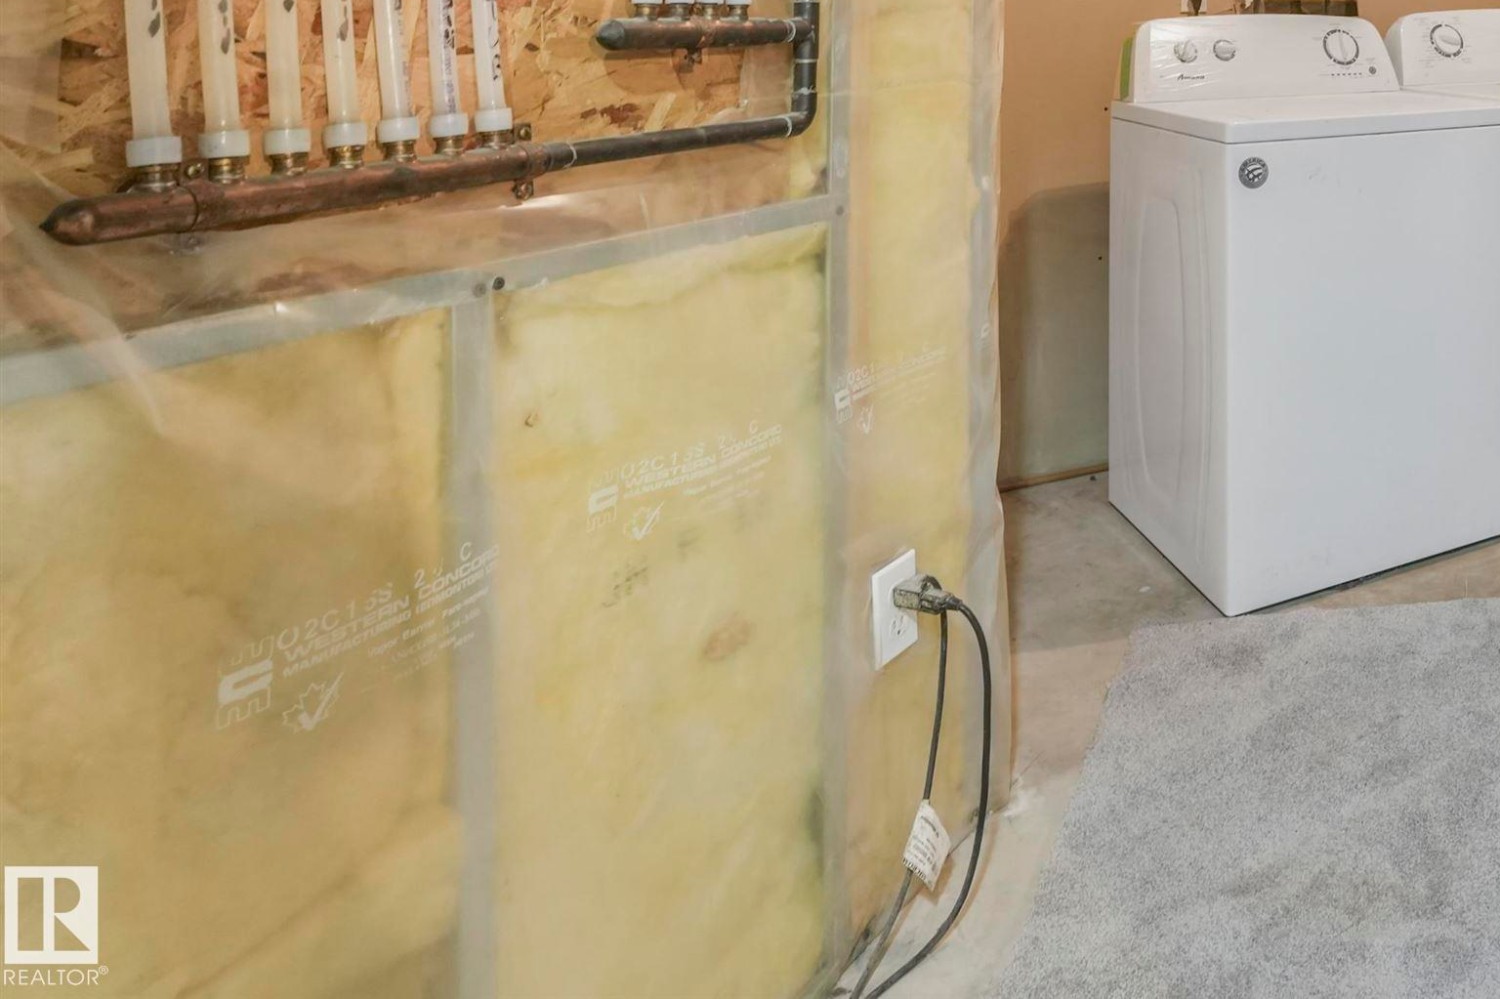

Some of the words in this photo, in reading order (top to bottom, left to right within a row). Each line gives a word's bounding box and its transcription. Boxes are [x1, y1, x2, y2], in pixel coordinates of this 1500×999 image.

[283, 610, 412, 679] MANUFACTURING
[284, 595, 410, 662] WESTERN
[417, 544, 500, 599] CONCORD
